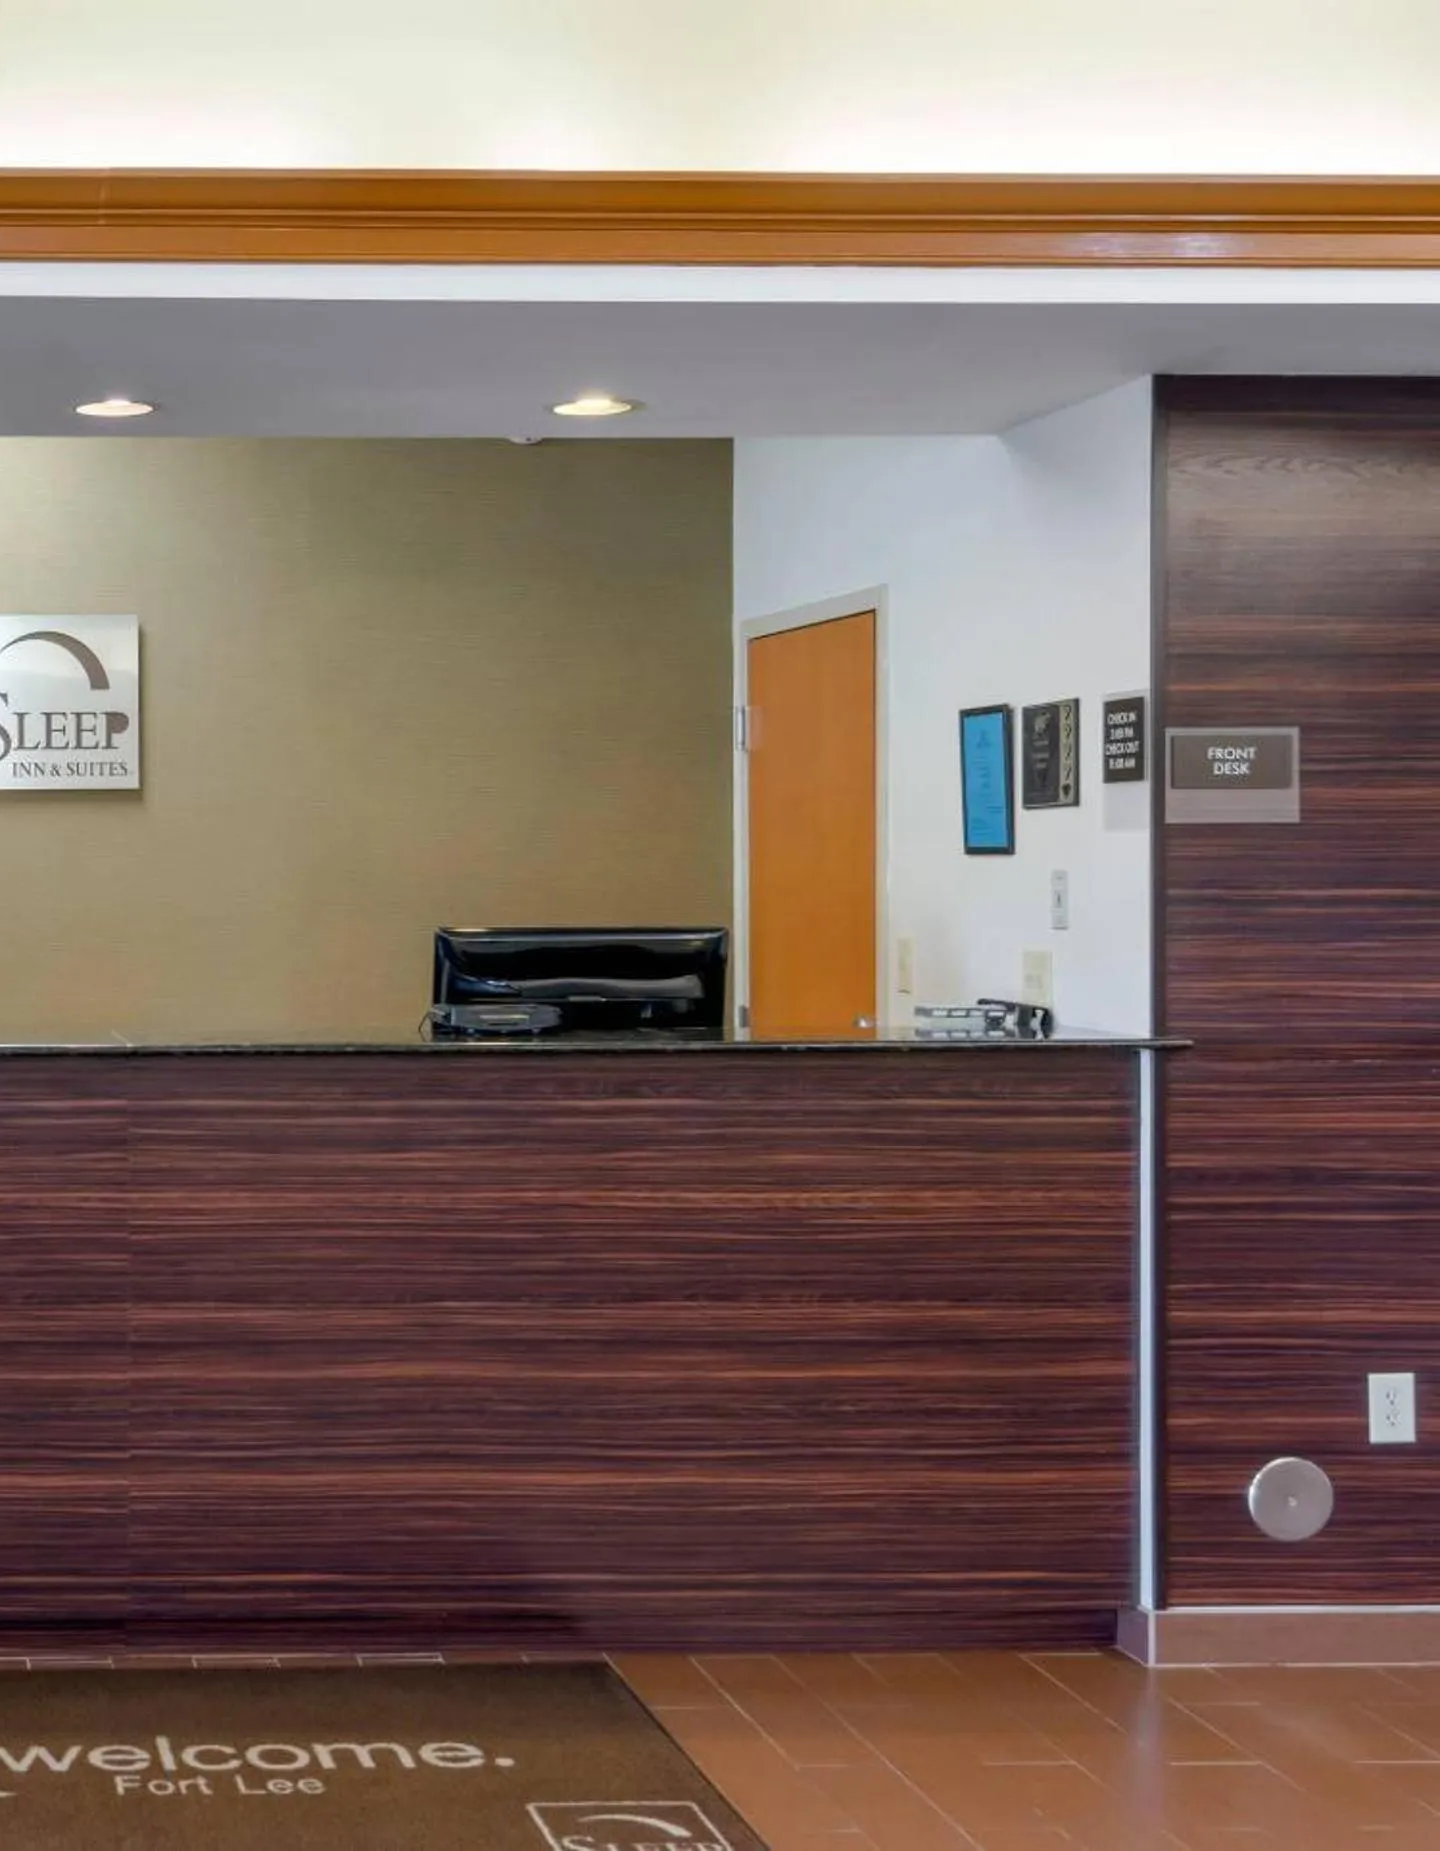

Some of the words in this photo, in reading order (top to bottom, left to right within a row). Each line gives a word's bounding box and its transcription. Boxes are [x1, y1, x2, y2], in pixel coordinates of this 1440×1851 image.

[1207, 746, 1257, 759] FRONT
[12, 762, 46, 778] INN
[49, 763, 62, 777] &
[66, 761, 129, 777] SUITES
[1213, 762, 1250, 775] DESK
[113, 1774, 214, 1796] Fort
[234, 1774, 327, 1796] Lee
